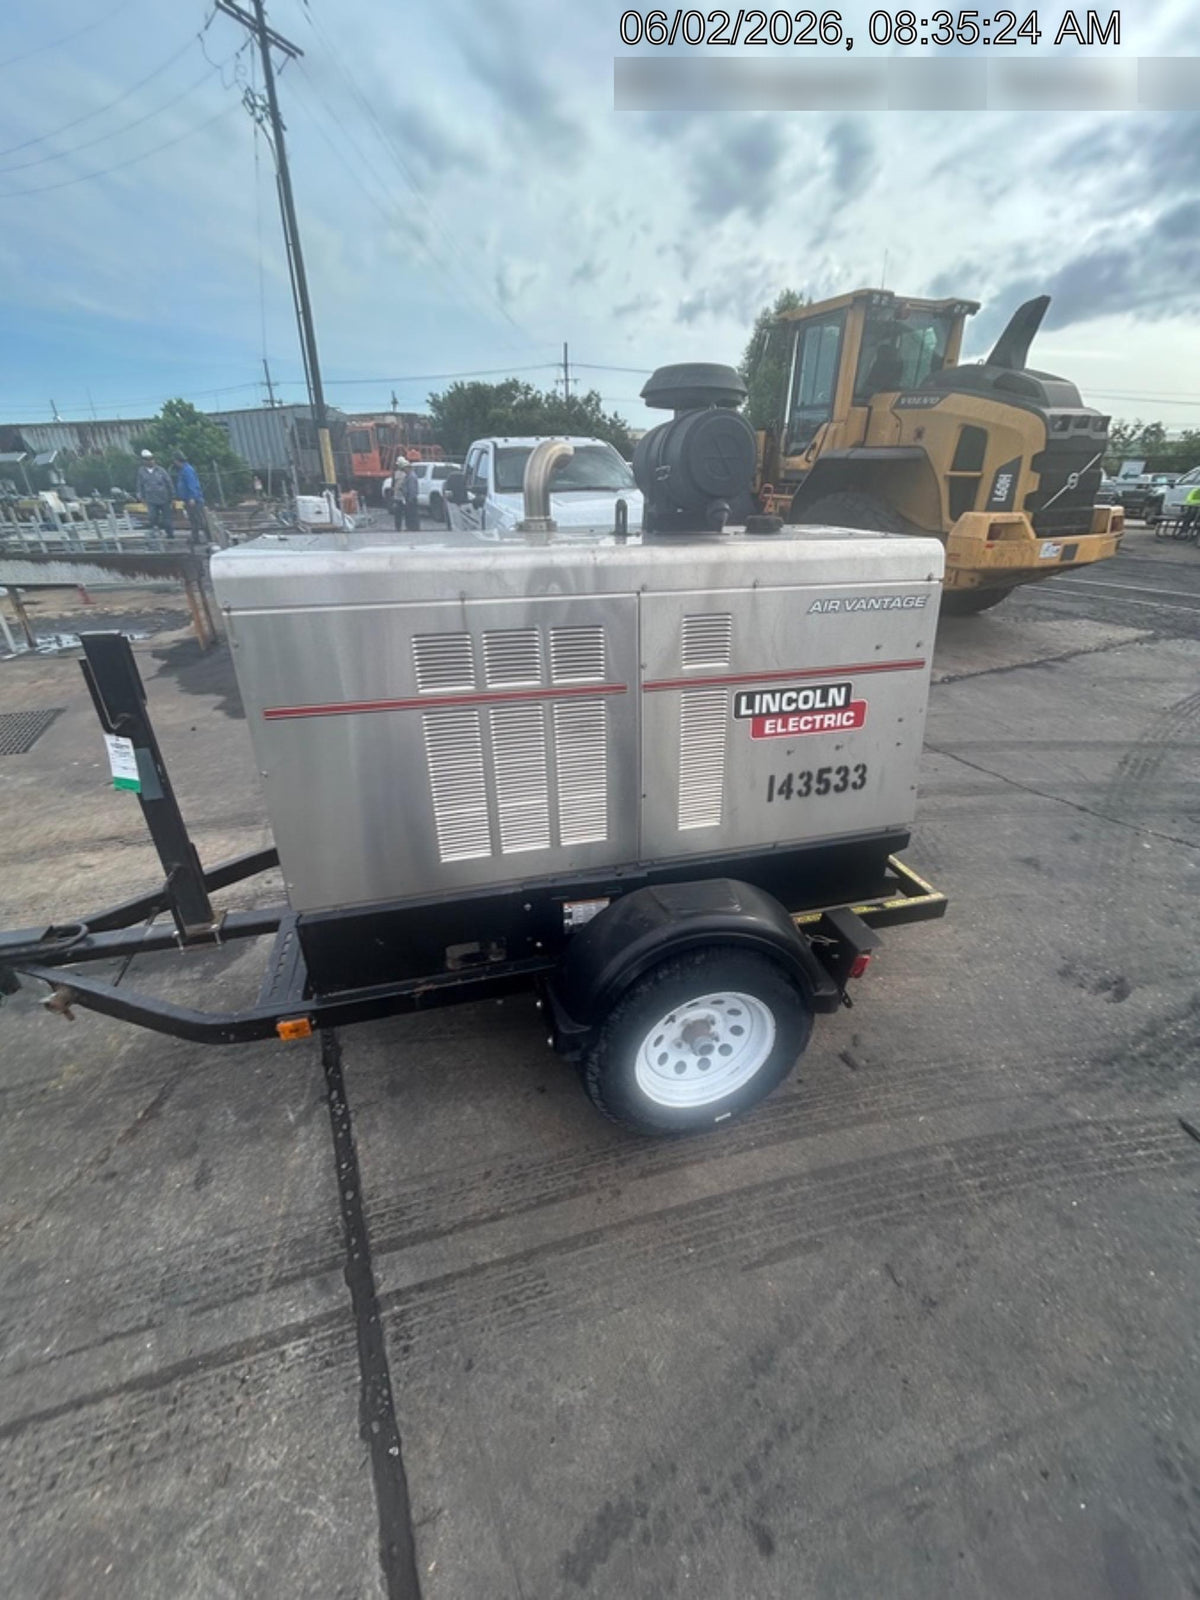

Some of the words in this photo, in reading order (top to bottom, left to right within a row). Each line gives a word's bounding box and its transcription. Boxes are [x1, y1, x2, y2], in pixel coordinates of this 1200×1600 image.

[808, 599, 841, 614] AIR
[843, 595, 929, 611] VANTAGE
[740, 687, 846, 716] LINCOLN
[764, 711, 855, 735] ELECTRIC
[766, 763, 868, 803] 143533
